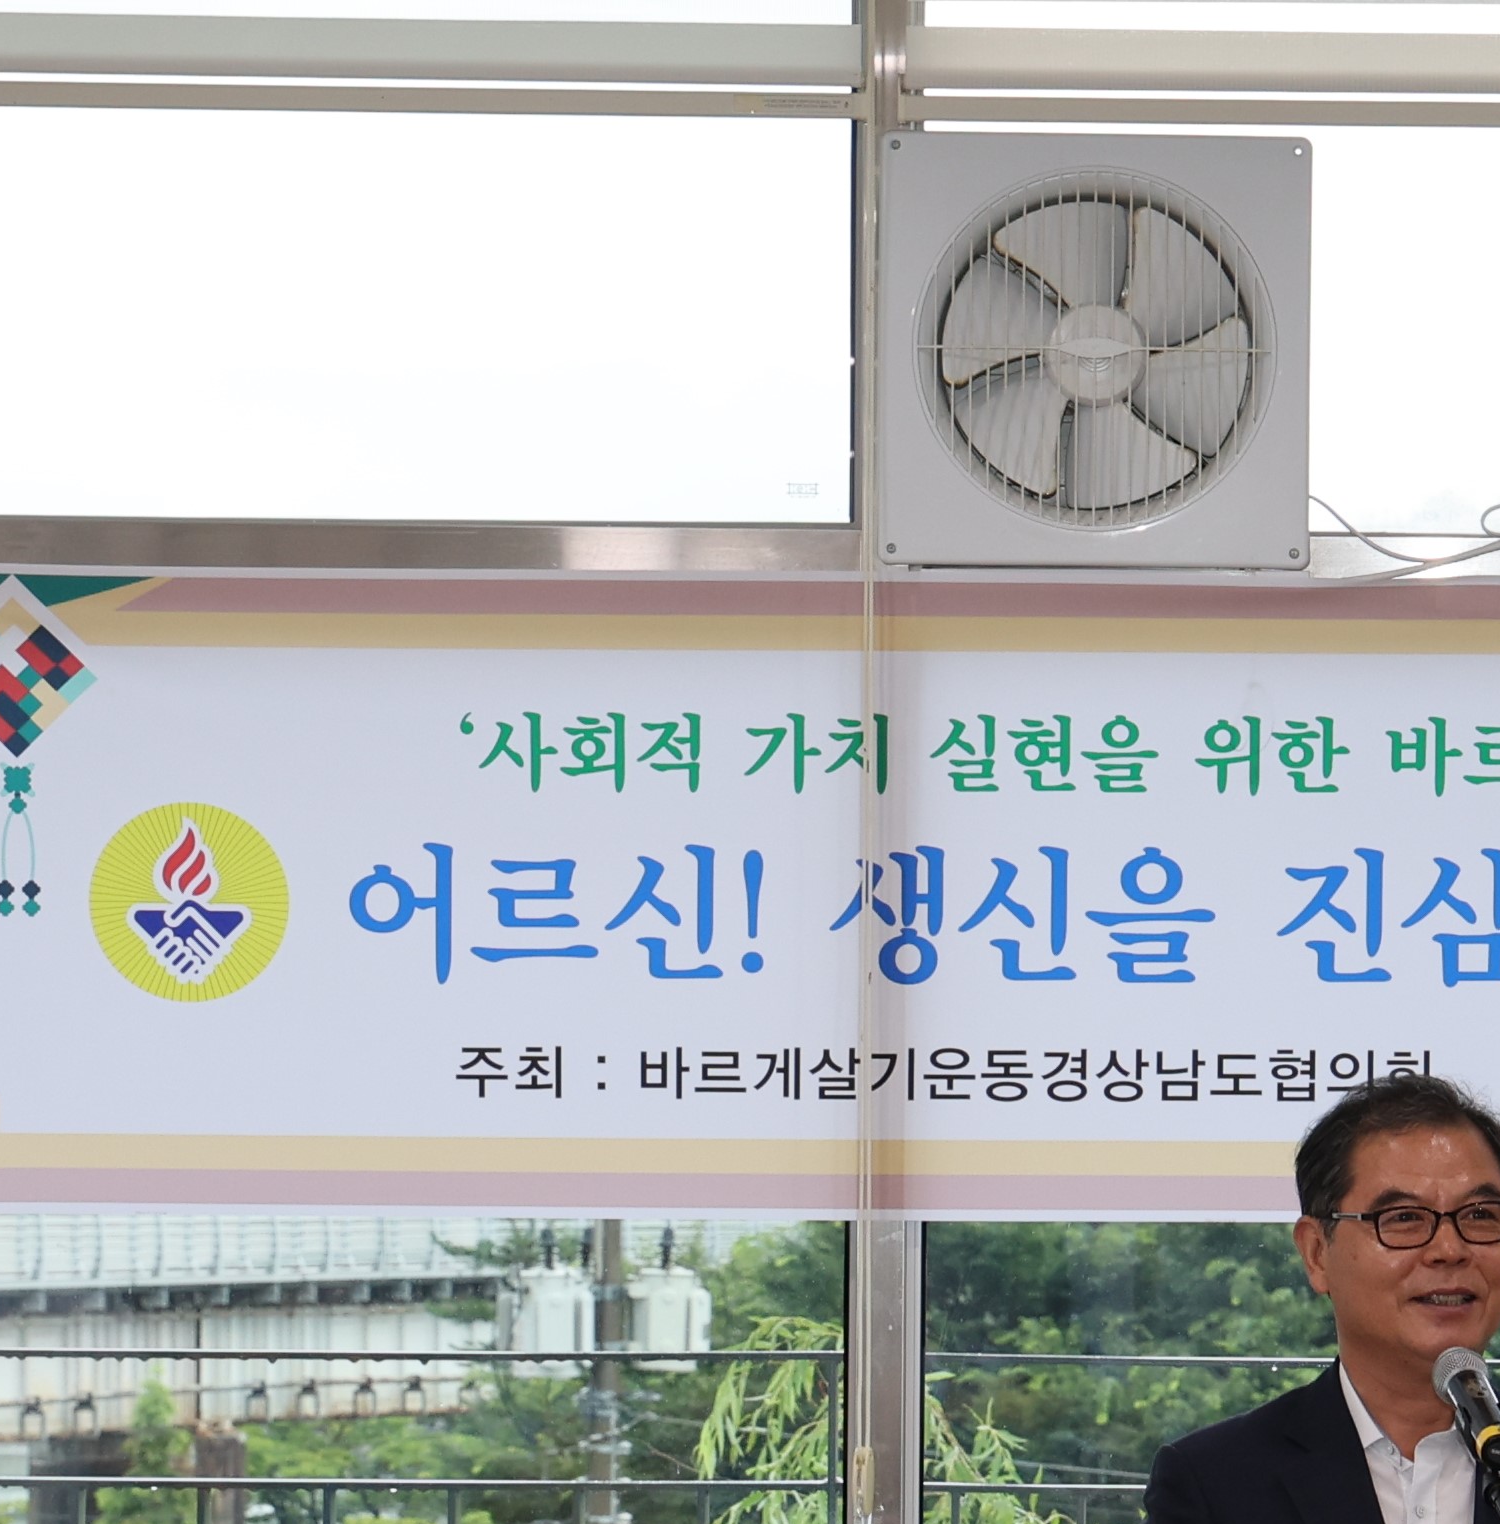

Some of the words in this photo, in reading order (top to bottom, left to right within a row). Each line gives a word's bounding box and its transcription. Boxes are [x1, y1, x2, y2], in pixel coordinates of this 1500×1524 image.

[744, 713, 885, 794] 가치
[929, 714, 1159, 796] 실현을
[1195, 716, 1350, 796] 위한
[348, 841, 766, 985] 어르신!
[830, 843, 1217, 986] 생신을
[455, 1046, 563, 1100] 주최
